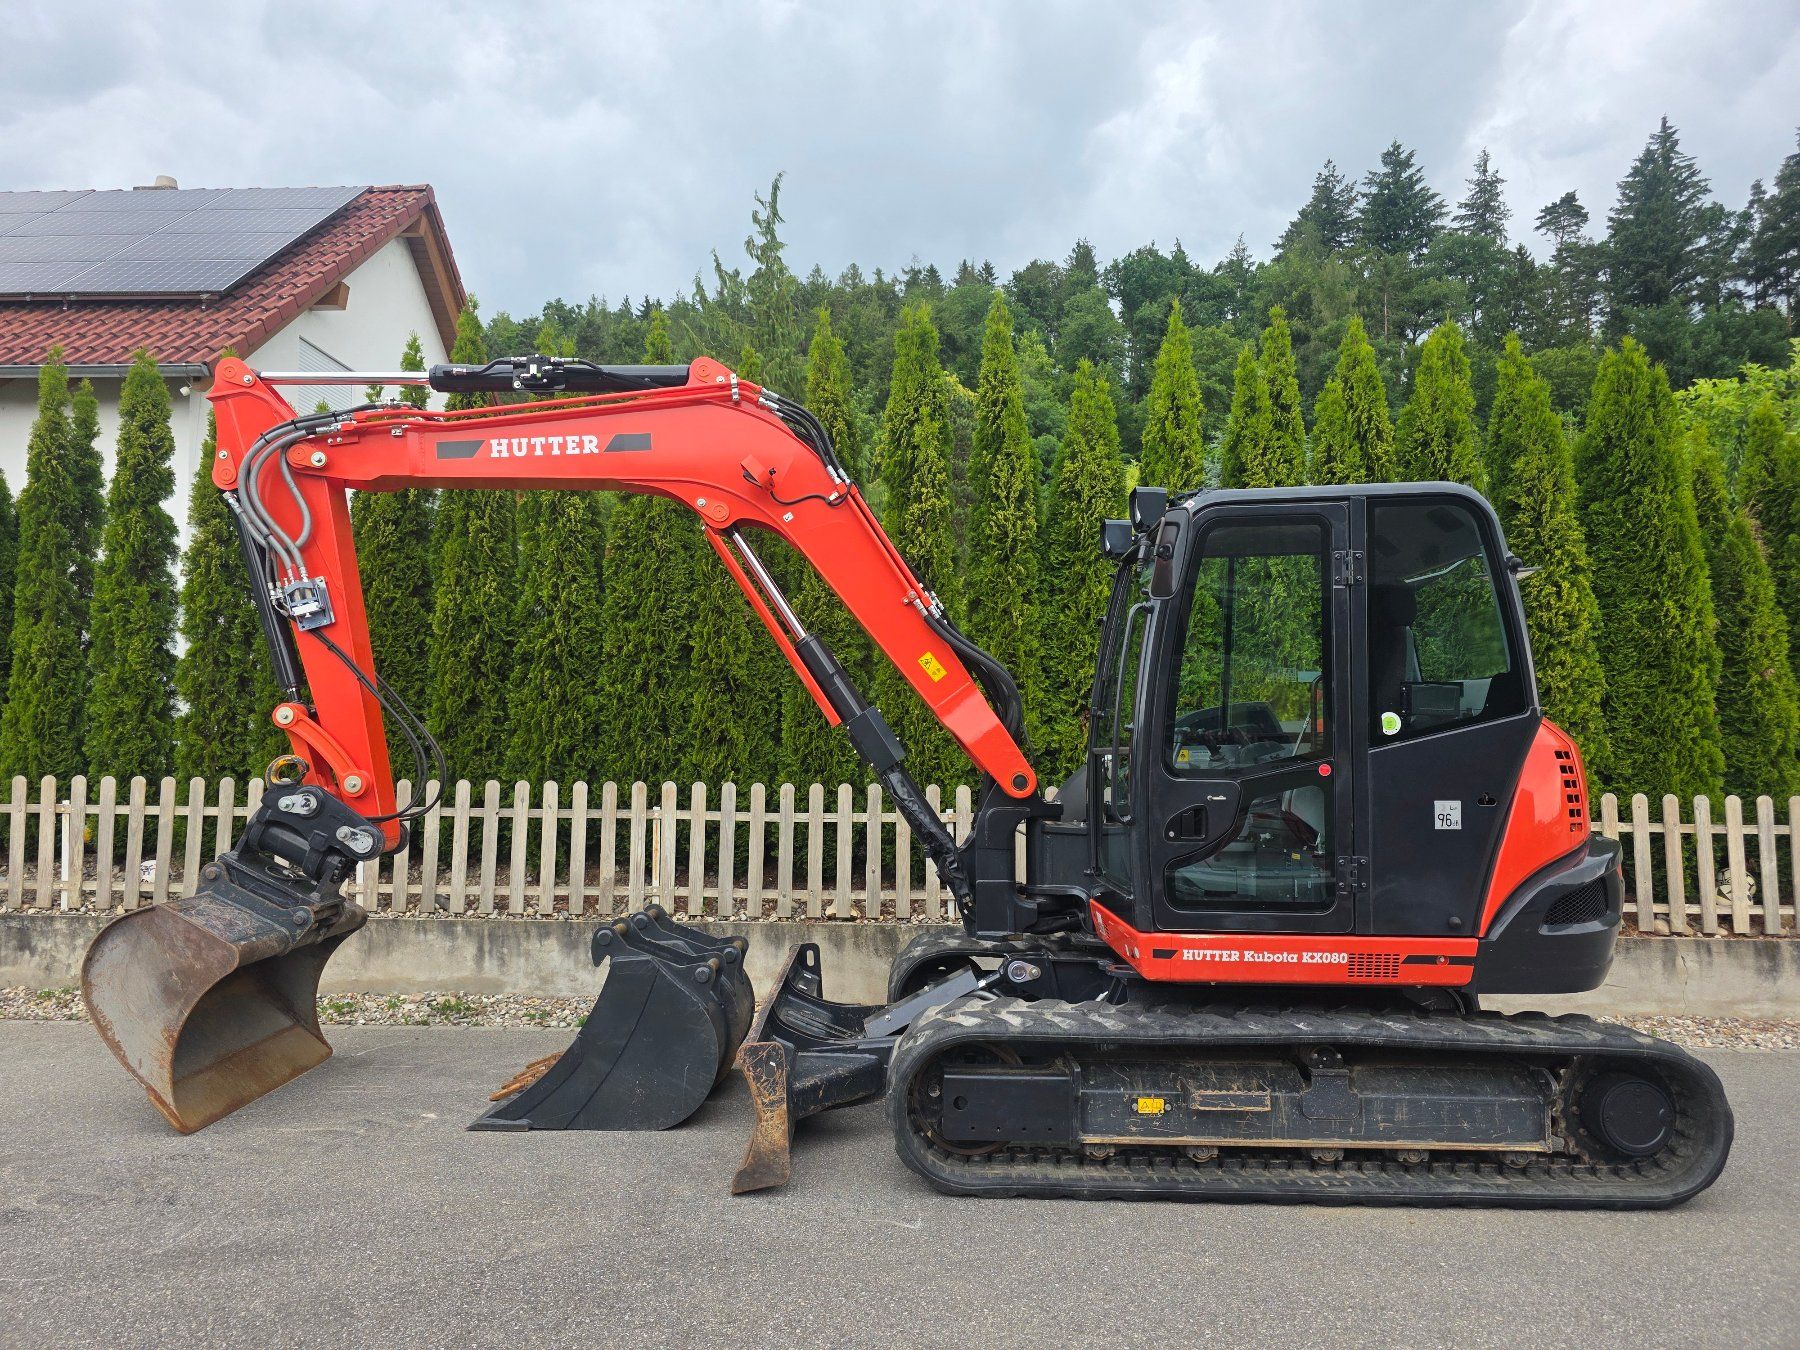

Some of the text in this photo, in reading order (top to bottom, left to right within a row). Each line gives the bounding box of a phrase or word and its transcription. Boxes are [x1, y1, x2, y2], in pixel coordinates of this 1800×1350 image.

[489, 435, 599, 458] HUTTER
[1437, 813, 1452, 827] 96
[1182, 949, 1348, 964] HUTTER Kubota KX080
